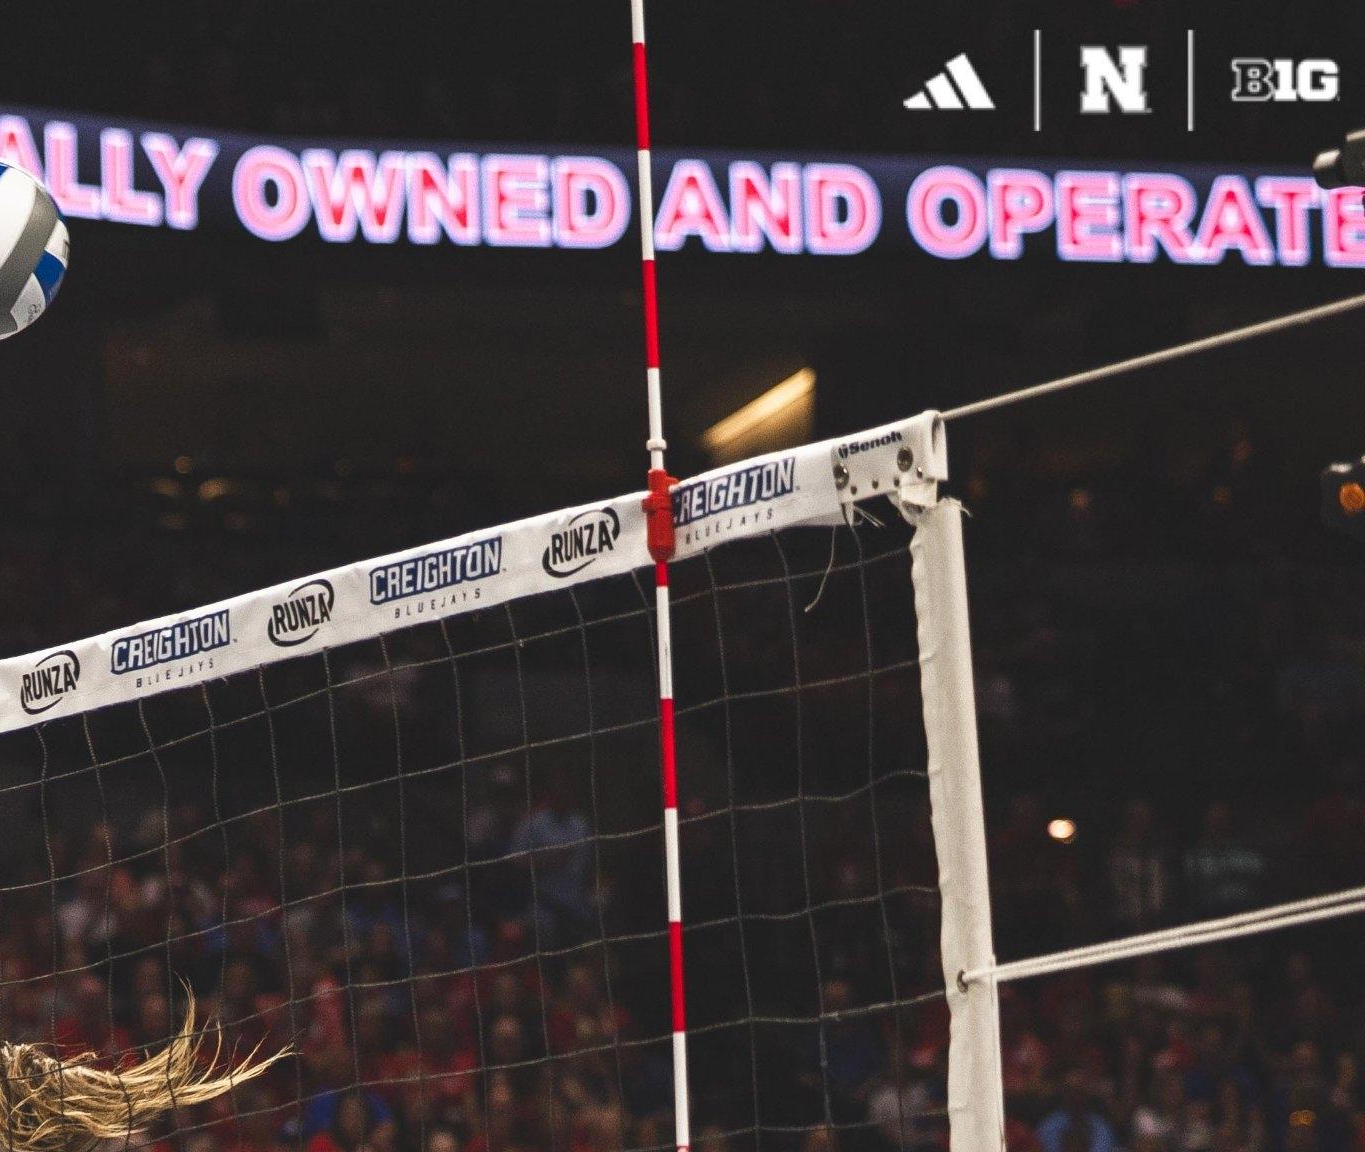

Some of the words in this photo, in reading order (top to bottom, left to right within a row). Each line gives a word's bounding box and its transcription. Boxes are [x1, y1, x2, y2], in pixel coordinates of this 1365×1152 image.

[233, 144, 630, 249] OWNED
[653, 157, 882, 255] AND
[672, 457, 796, 528] REIGHTON
[551, 519, 614, 566] RUNZA
[685, 507, 774, 546] BLUEJAYS
[369, 536, 502, 605] CREIGHTON
[273, 591, 332, 639] RUNZA
[394, 587, 482, 619] BLUEJAYS
[111, 609, 230, 674] CREIGHTON
[22, 662, 77, 705] RUNZA
[136, 657, 215, 688] BLUEJAYS
